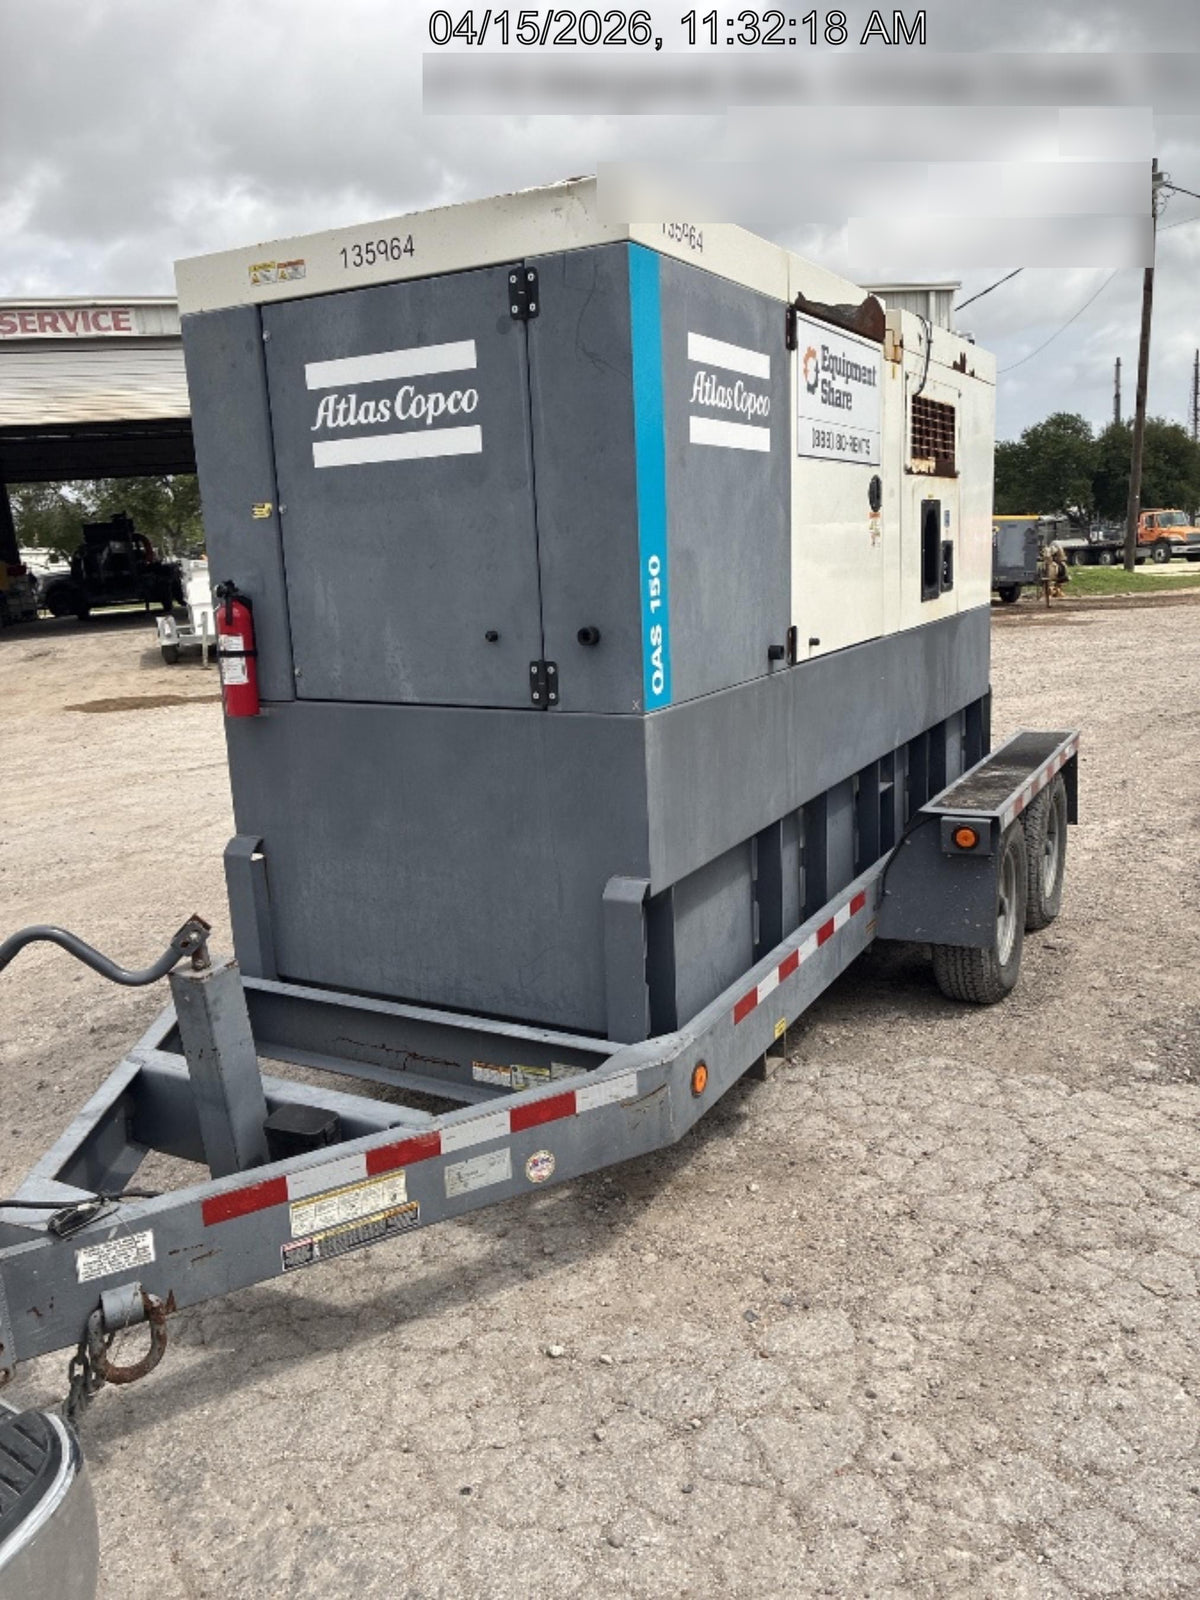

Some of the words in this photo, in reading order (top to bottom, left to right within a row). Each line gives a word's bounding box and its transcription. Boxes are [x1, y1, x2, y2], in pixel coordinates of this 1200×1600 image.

[340, 234, 415, 269] 135964
[0, 310, 132, 334] SERVICE
[821, 344, 877, 387] Equipment
[310, 393, 391, 431] Atlas
[394, 385, 479, 425] Copco
[689, 371, 733, 410] Atlas
[733, 379, 771, 420] Copco
[821, 378, 853, 411] Share
[648, 555, 661, 614] 150
